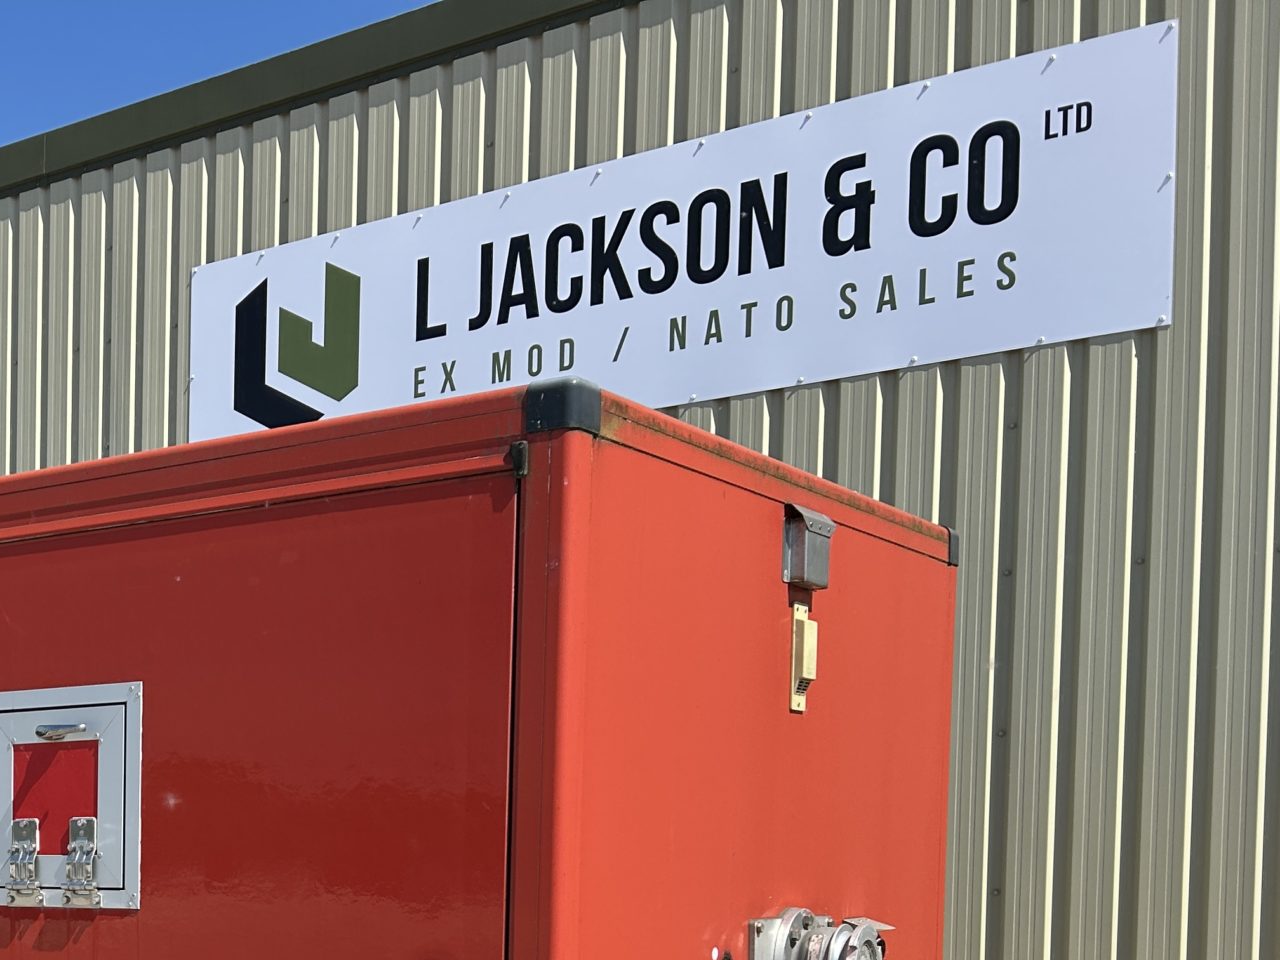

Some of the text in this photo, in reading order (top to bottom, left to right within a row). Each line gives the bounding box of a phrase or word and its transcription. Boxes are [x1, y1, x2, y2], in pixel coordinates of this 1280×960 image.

[415, 100, 1093, 342] L JACKSON & CO LTD
[413, 251, 1017, 399] EX MOD / NATO SALES
